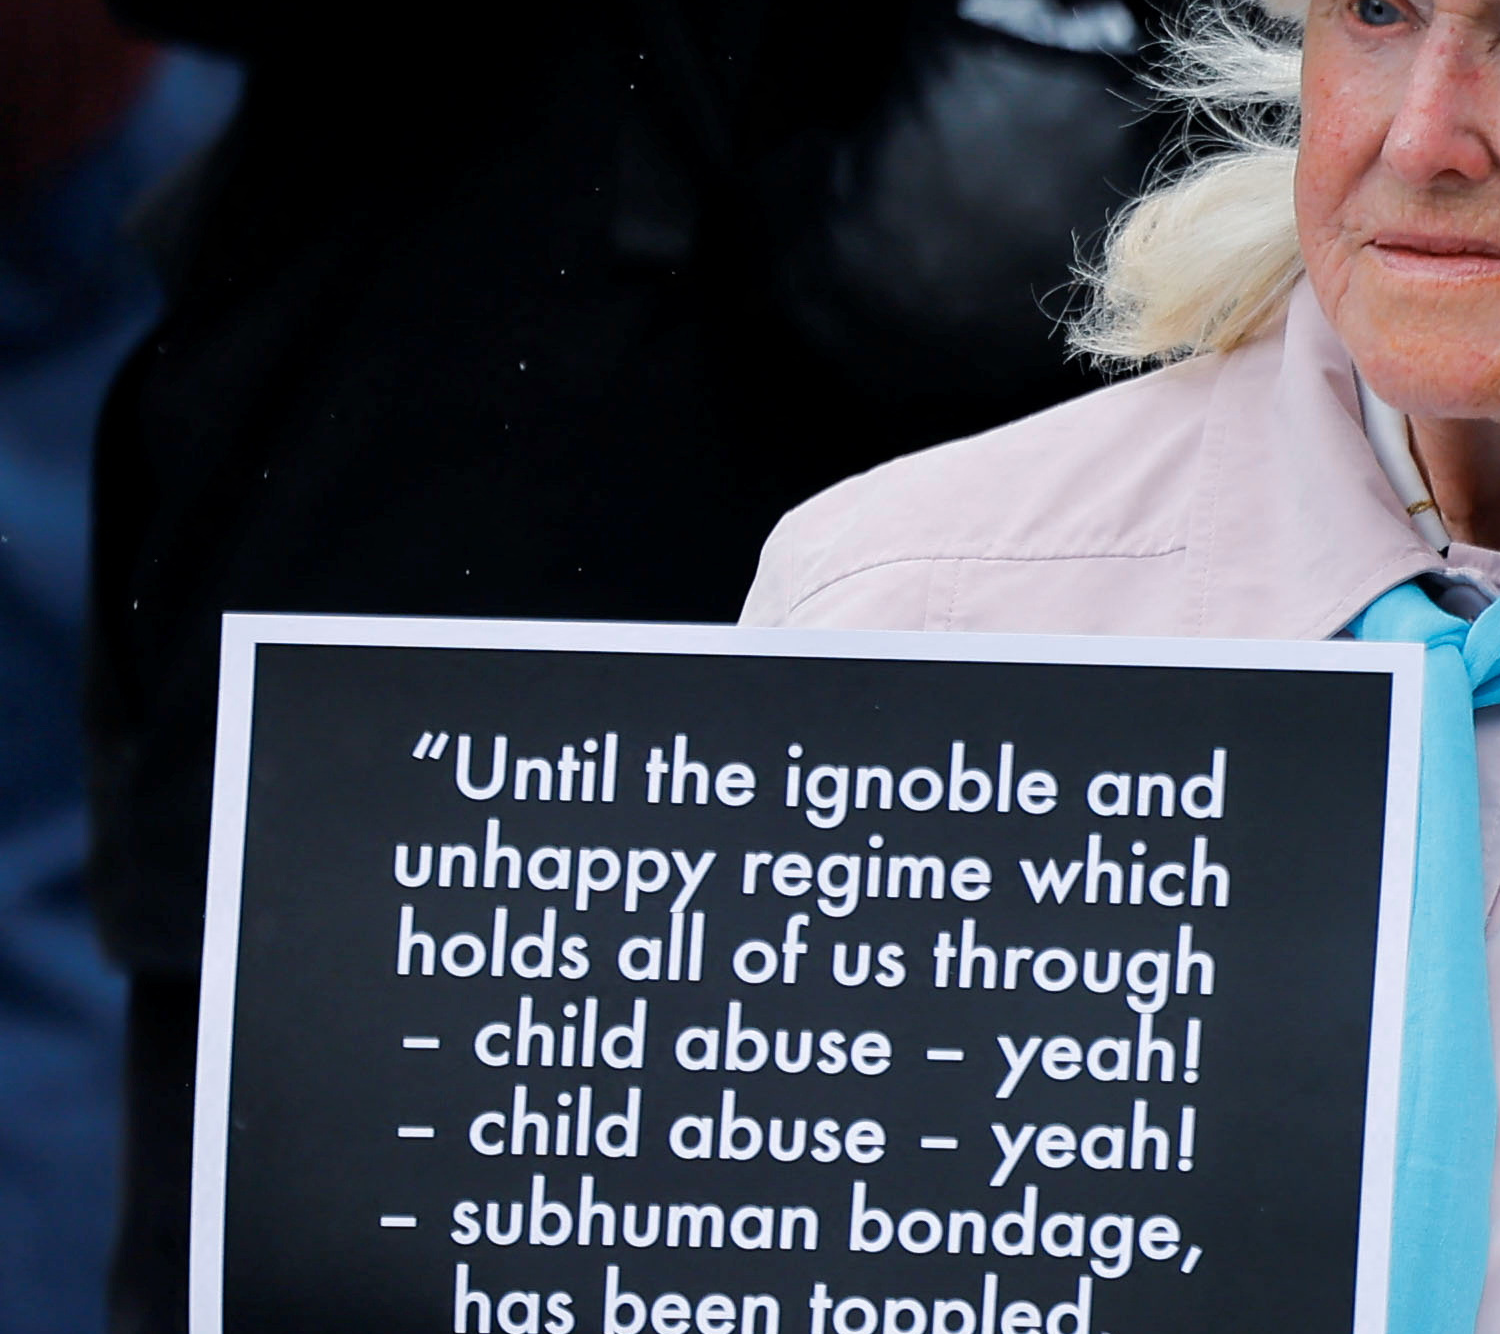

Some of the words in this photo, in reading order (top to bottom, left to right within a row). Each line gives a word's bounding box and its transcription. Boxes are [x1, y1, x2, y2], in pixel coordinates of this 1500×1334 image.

[645, 733, 756, 807] the
[785, 740, 1058, 829] ignoble
[1086, 747, 1227, 819] and
[394, 817, 713, 913] unhappy
[742, 833, 992, 918] regime
[1018, 832, 1230, 907] which
[397, 903, 590, 980] holds
[617, 912, 705, 982] all
[732, 912, 810, 984] of
[832, 942, 906, 988] us
[933, 917, 1215, 1013] through
[474, 994, 648, 1069] child
[675, 999, 892, 1076] abuse
[995, 1013, 1202, 1099] yeah!
[468, 1083, 642, 1158] child
[668, 1088, 886, 1164] abuse
[989, 1098, 1196, 1187] yeah!
[450, 1173, 819, 1250] subhuman
[849, 1180, 1203, 1279] bondage,
